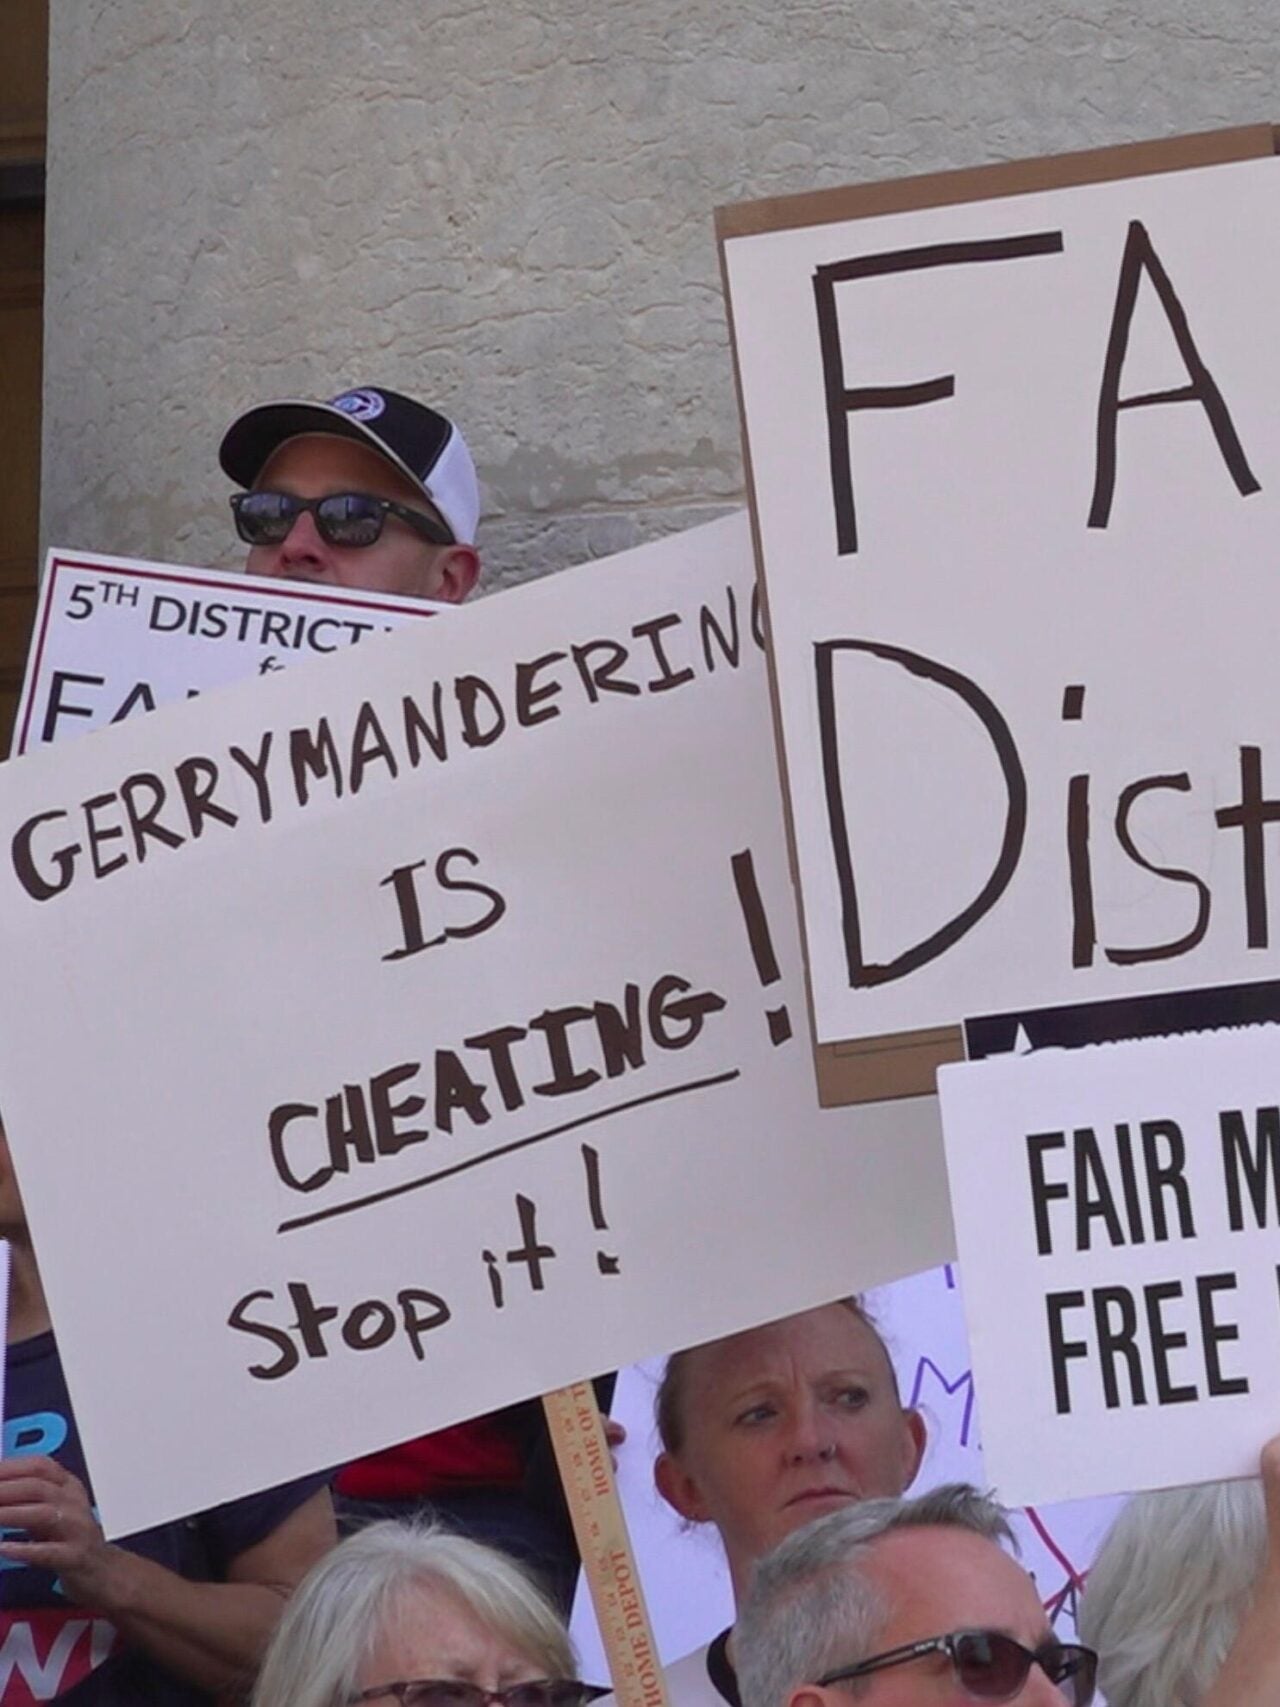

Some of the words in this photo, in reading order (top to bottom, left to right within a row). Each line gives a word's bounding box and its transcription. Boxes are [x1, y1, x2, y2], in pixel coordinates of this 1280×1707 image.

[379, 847, 506, 962] IS
[1025, 1118, 1197, 1256] FAIR
[227, 1281, 451, 1380] Stop
[1045, 1272, 1250, 1415] FREE
